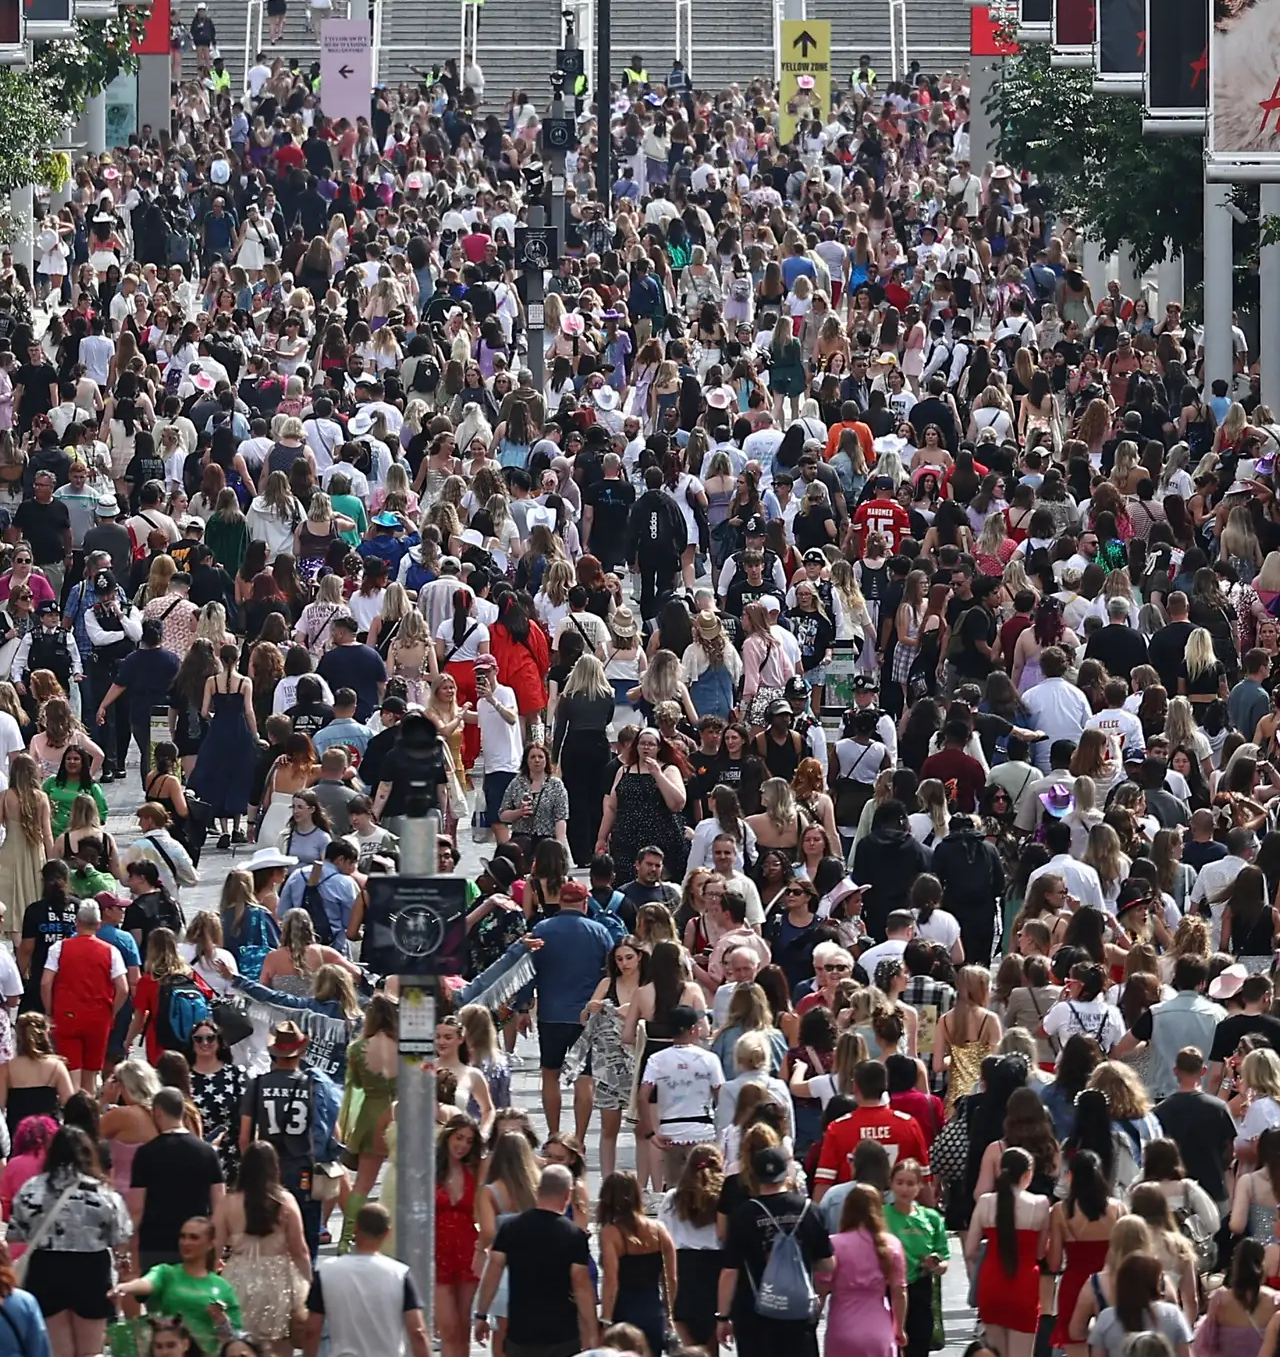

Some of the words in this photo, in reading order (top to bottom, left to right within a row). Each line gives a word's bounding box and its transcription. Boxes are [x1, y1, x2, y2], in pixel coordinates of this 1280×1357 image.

[781, 62, 809, 72] YELLOW
[867, 507, 893, 517] MAHOMES
[649, 511, 658, 539] adidas
[1099, 719, 1120, 729] KELCE
[263, 1099, 308, 1136] 13
[860, 1125, 892, 1139] KELCE
